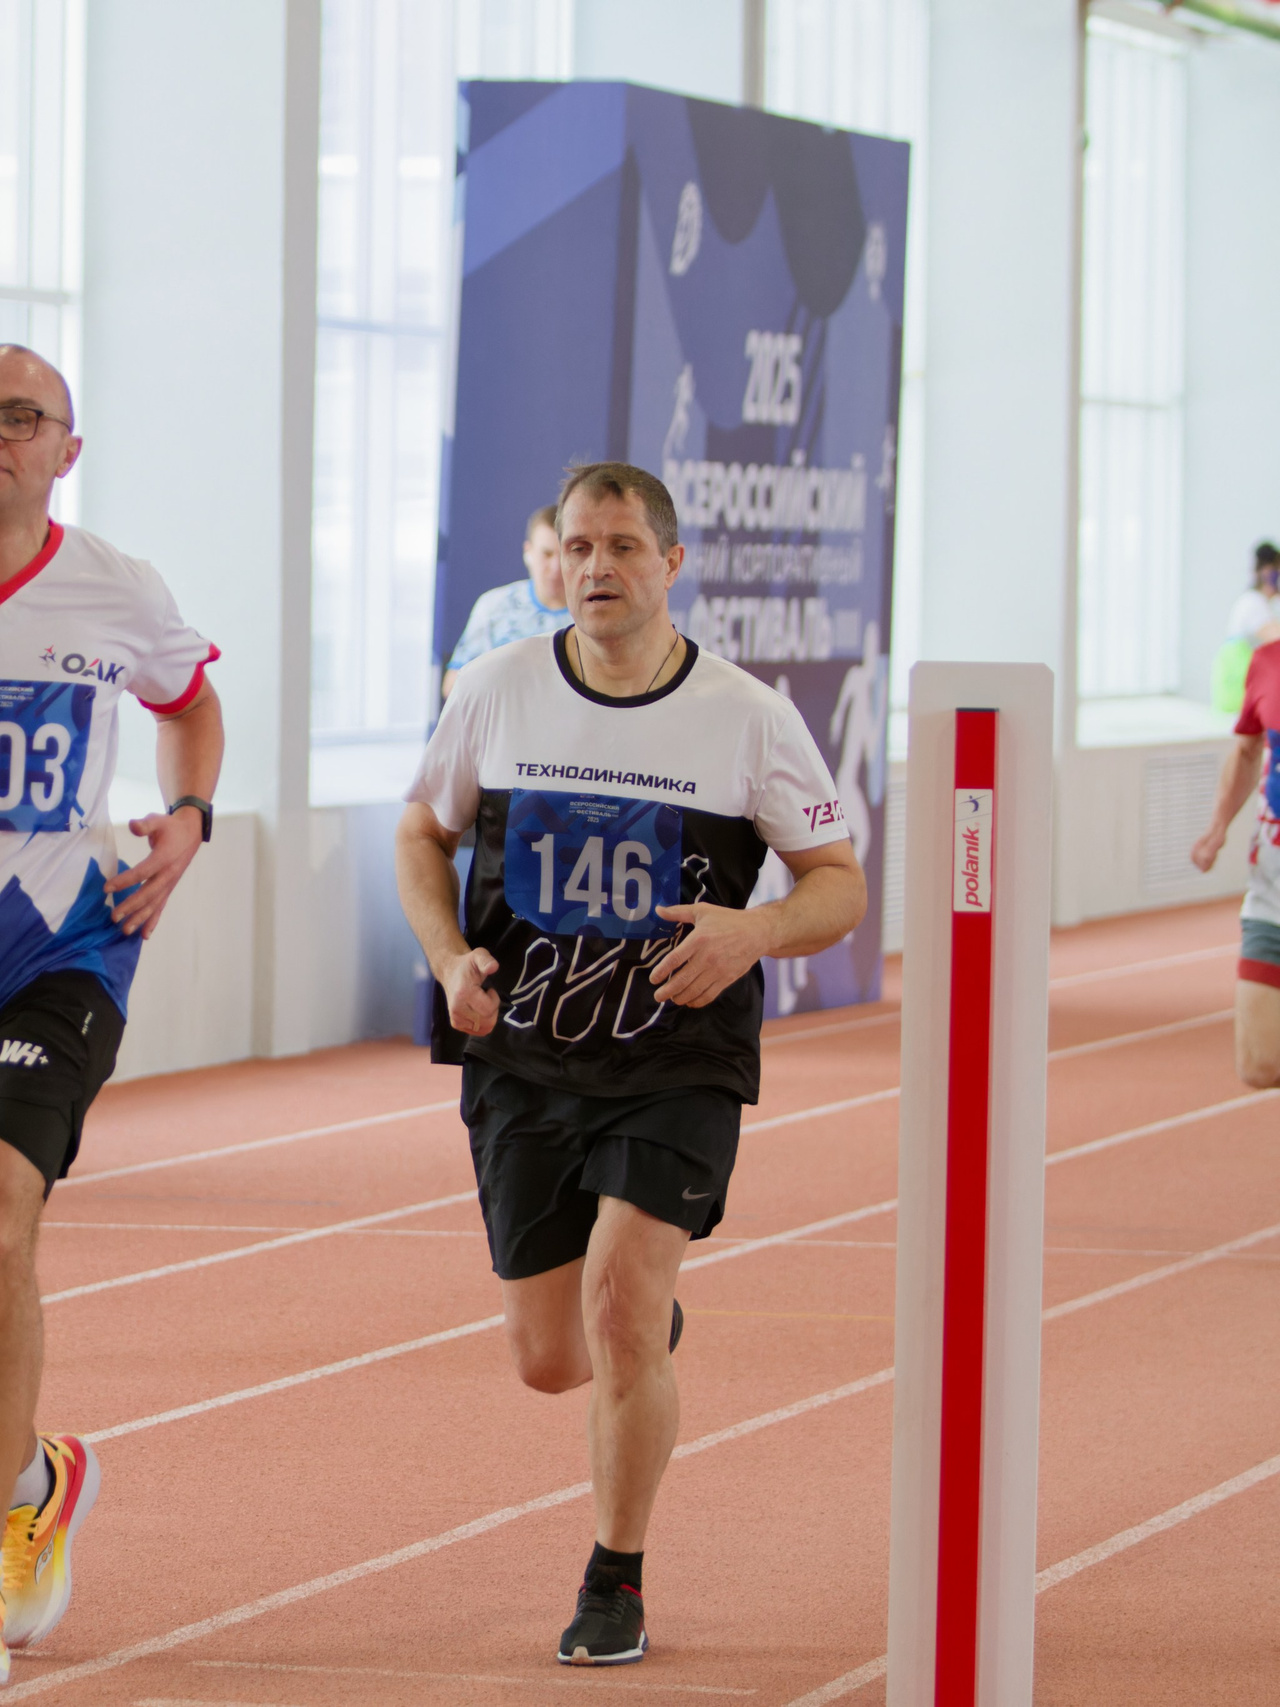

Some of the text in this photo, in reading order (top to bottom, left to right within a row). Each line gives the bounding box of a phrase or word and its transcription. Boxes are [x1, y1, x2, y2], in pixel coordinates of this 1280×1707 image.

[742, 329, 802, 424] 2025
[516, 762, 696, 795] ТЕХНОДИНАМИКА
[531, 833, 652, 921] 146
